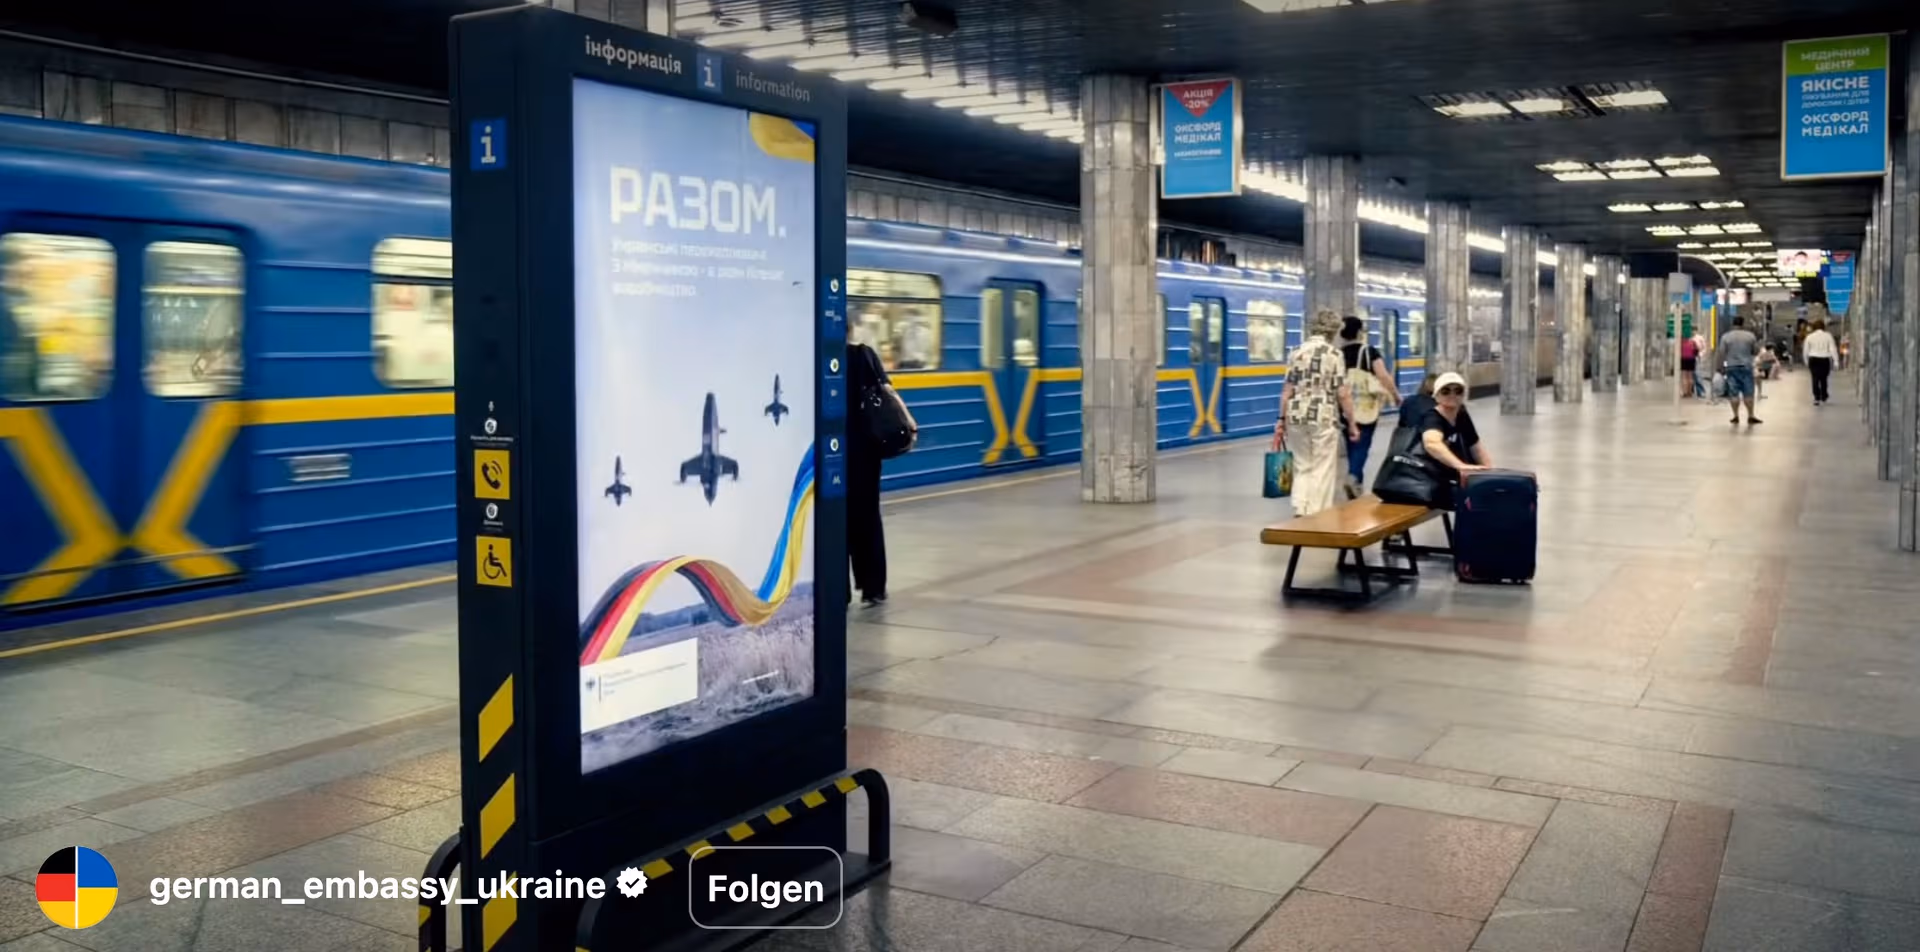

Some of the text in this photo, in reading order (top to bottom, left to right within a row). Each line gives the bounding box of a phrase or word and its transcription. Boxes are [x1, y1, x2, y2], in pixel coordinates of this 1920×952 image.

[585, 35, 683, 74] інформація
[1815, 60, 1855, 71] ЦЕНТР
[736, 70, 811, 102] information
[1801, 76, 1870, 92] ЯКІСНЕ
[1183, 88, 1213, 98] АКЦІЯ
[1185, 100, 1209, 109] -20%
[1801, 111, 1869, 125] ОКСФОРД
[1174, 121, 1221, 132] ОКСФОРД
[1801, 124, 1868, 137] МЕДІКАЛ
[610, 165, 787, 238] РАЗОМ.
